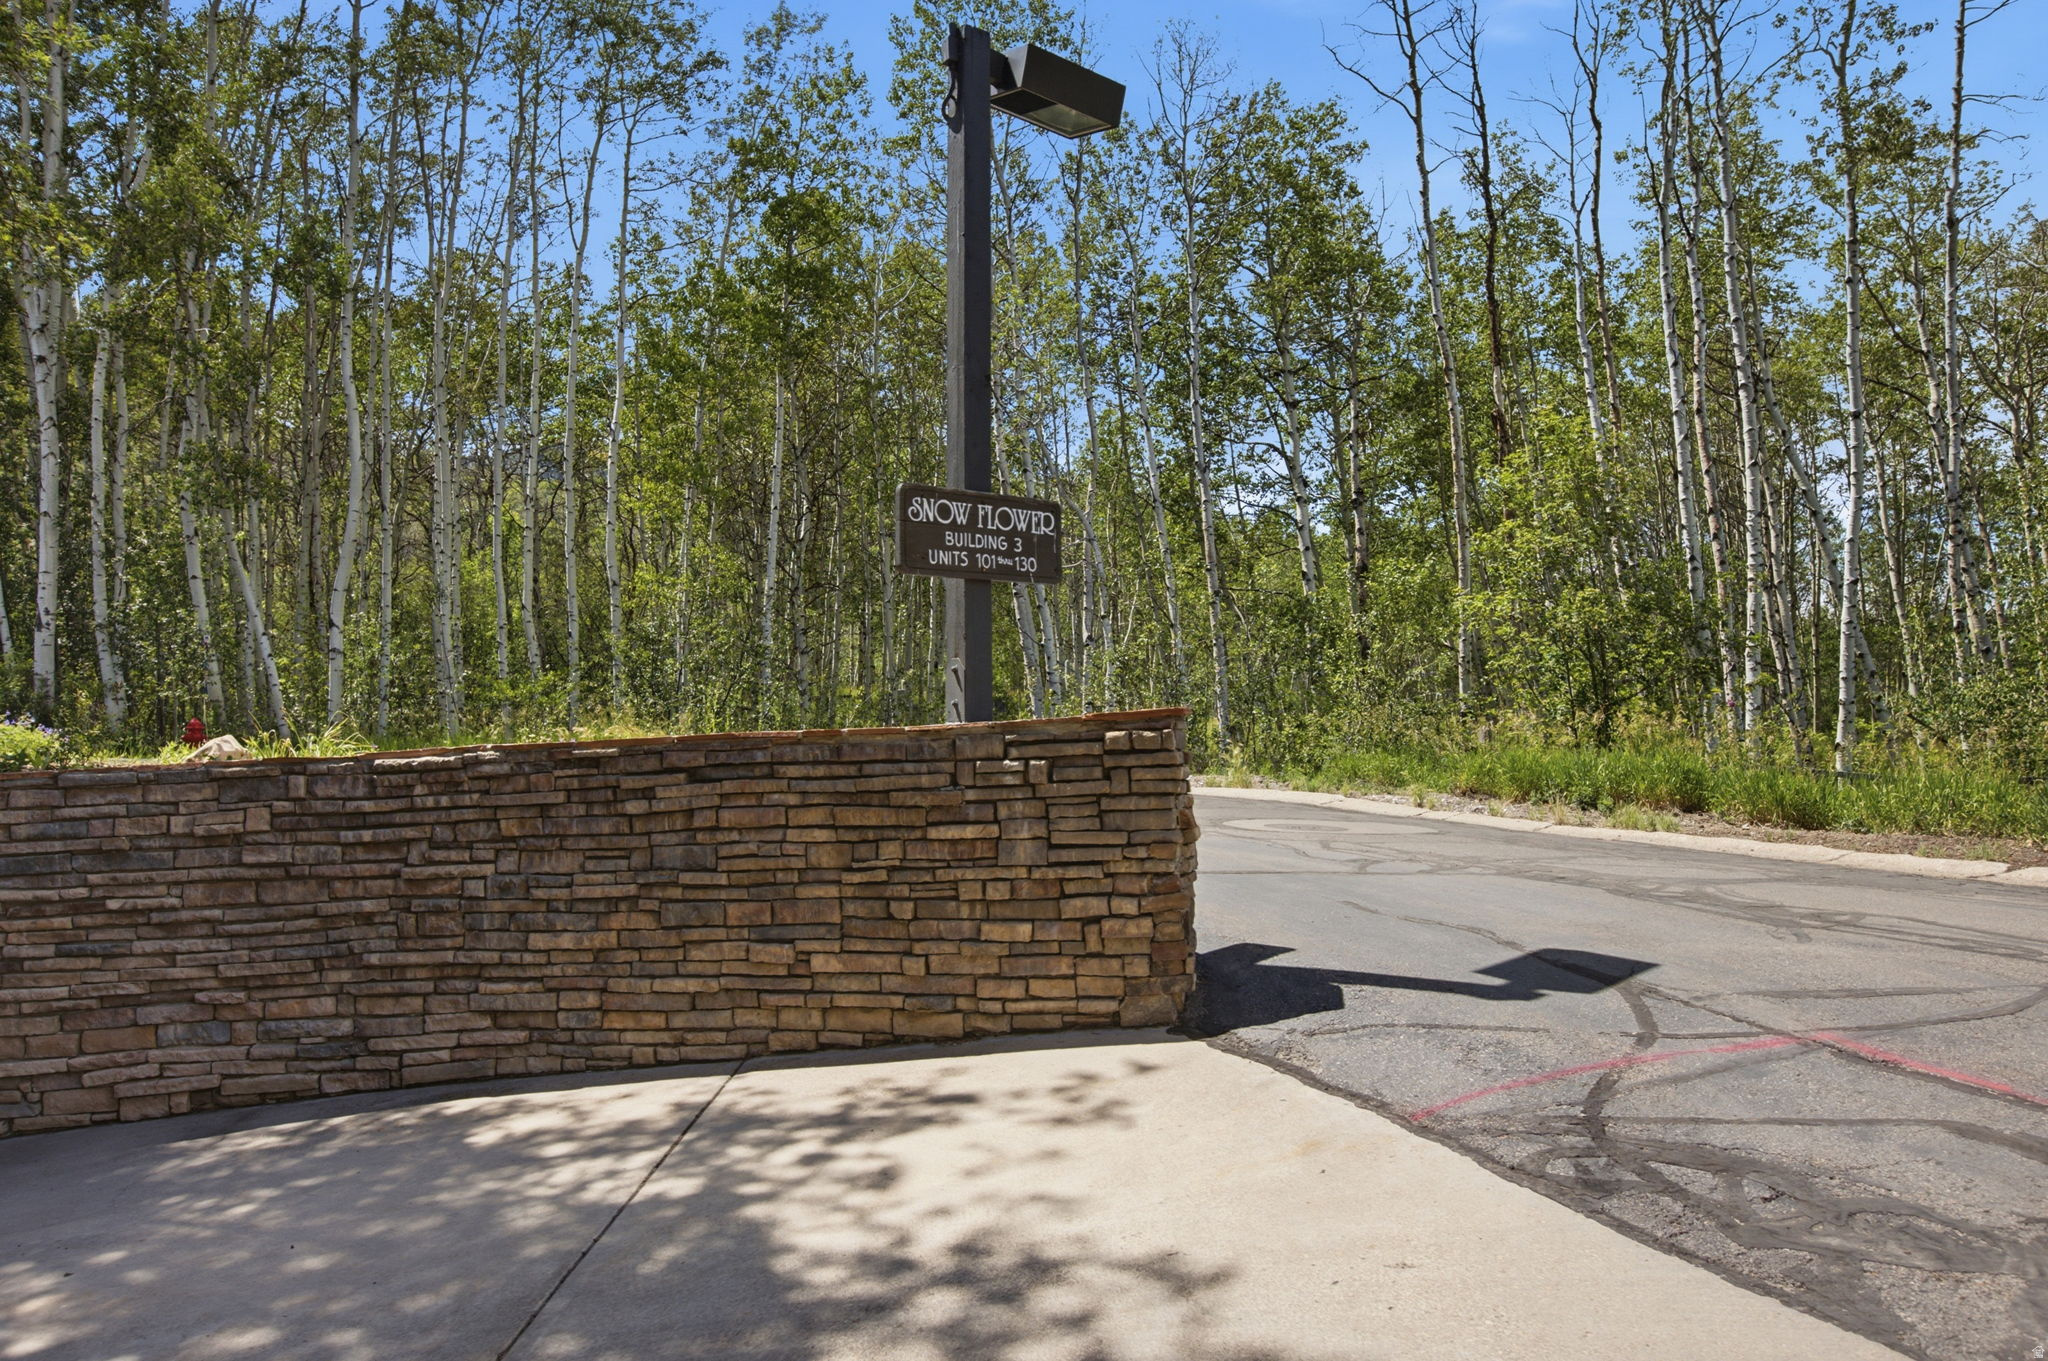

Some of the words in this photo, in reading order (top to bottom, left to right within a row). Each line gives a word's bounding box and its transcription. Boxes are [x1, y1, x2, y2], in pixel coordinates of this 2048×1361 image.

[908, 497, 972, 525] SNOW
[977, 504, 1055, 535] FLOWER
[945, 531, 1008, 550] BUILDING
[1014, 537, 1022, 552] 3
[928, 549, 969, 567] UNITS
[975, 553, 996, 569] 101
[1014, 556, 1037, 573] 130
